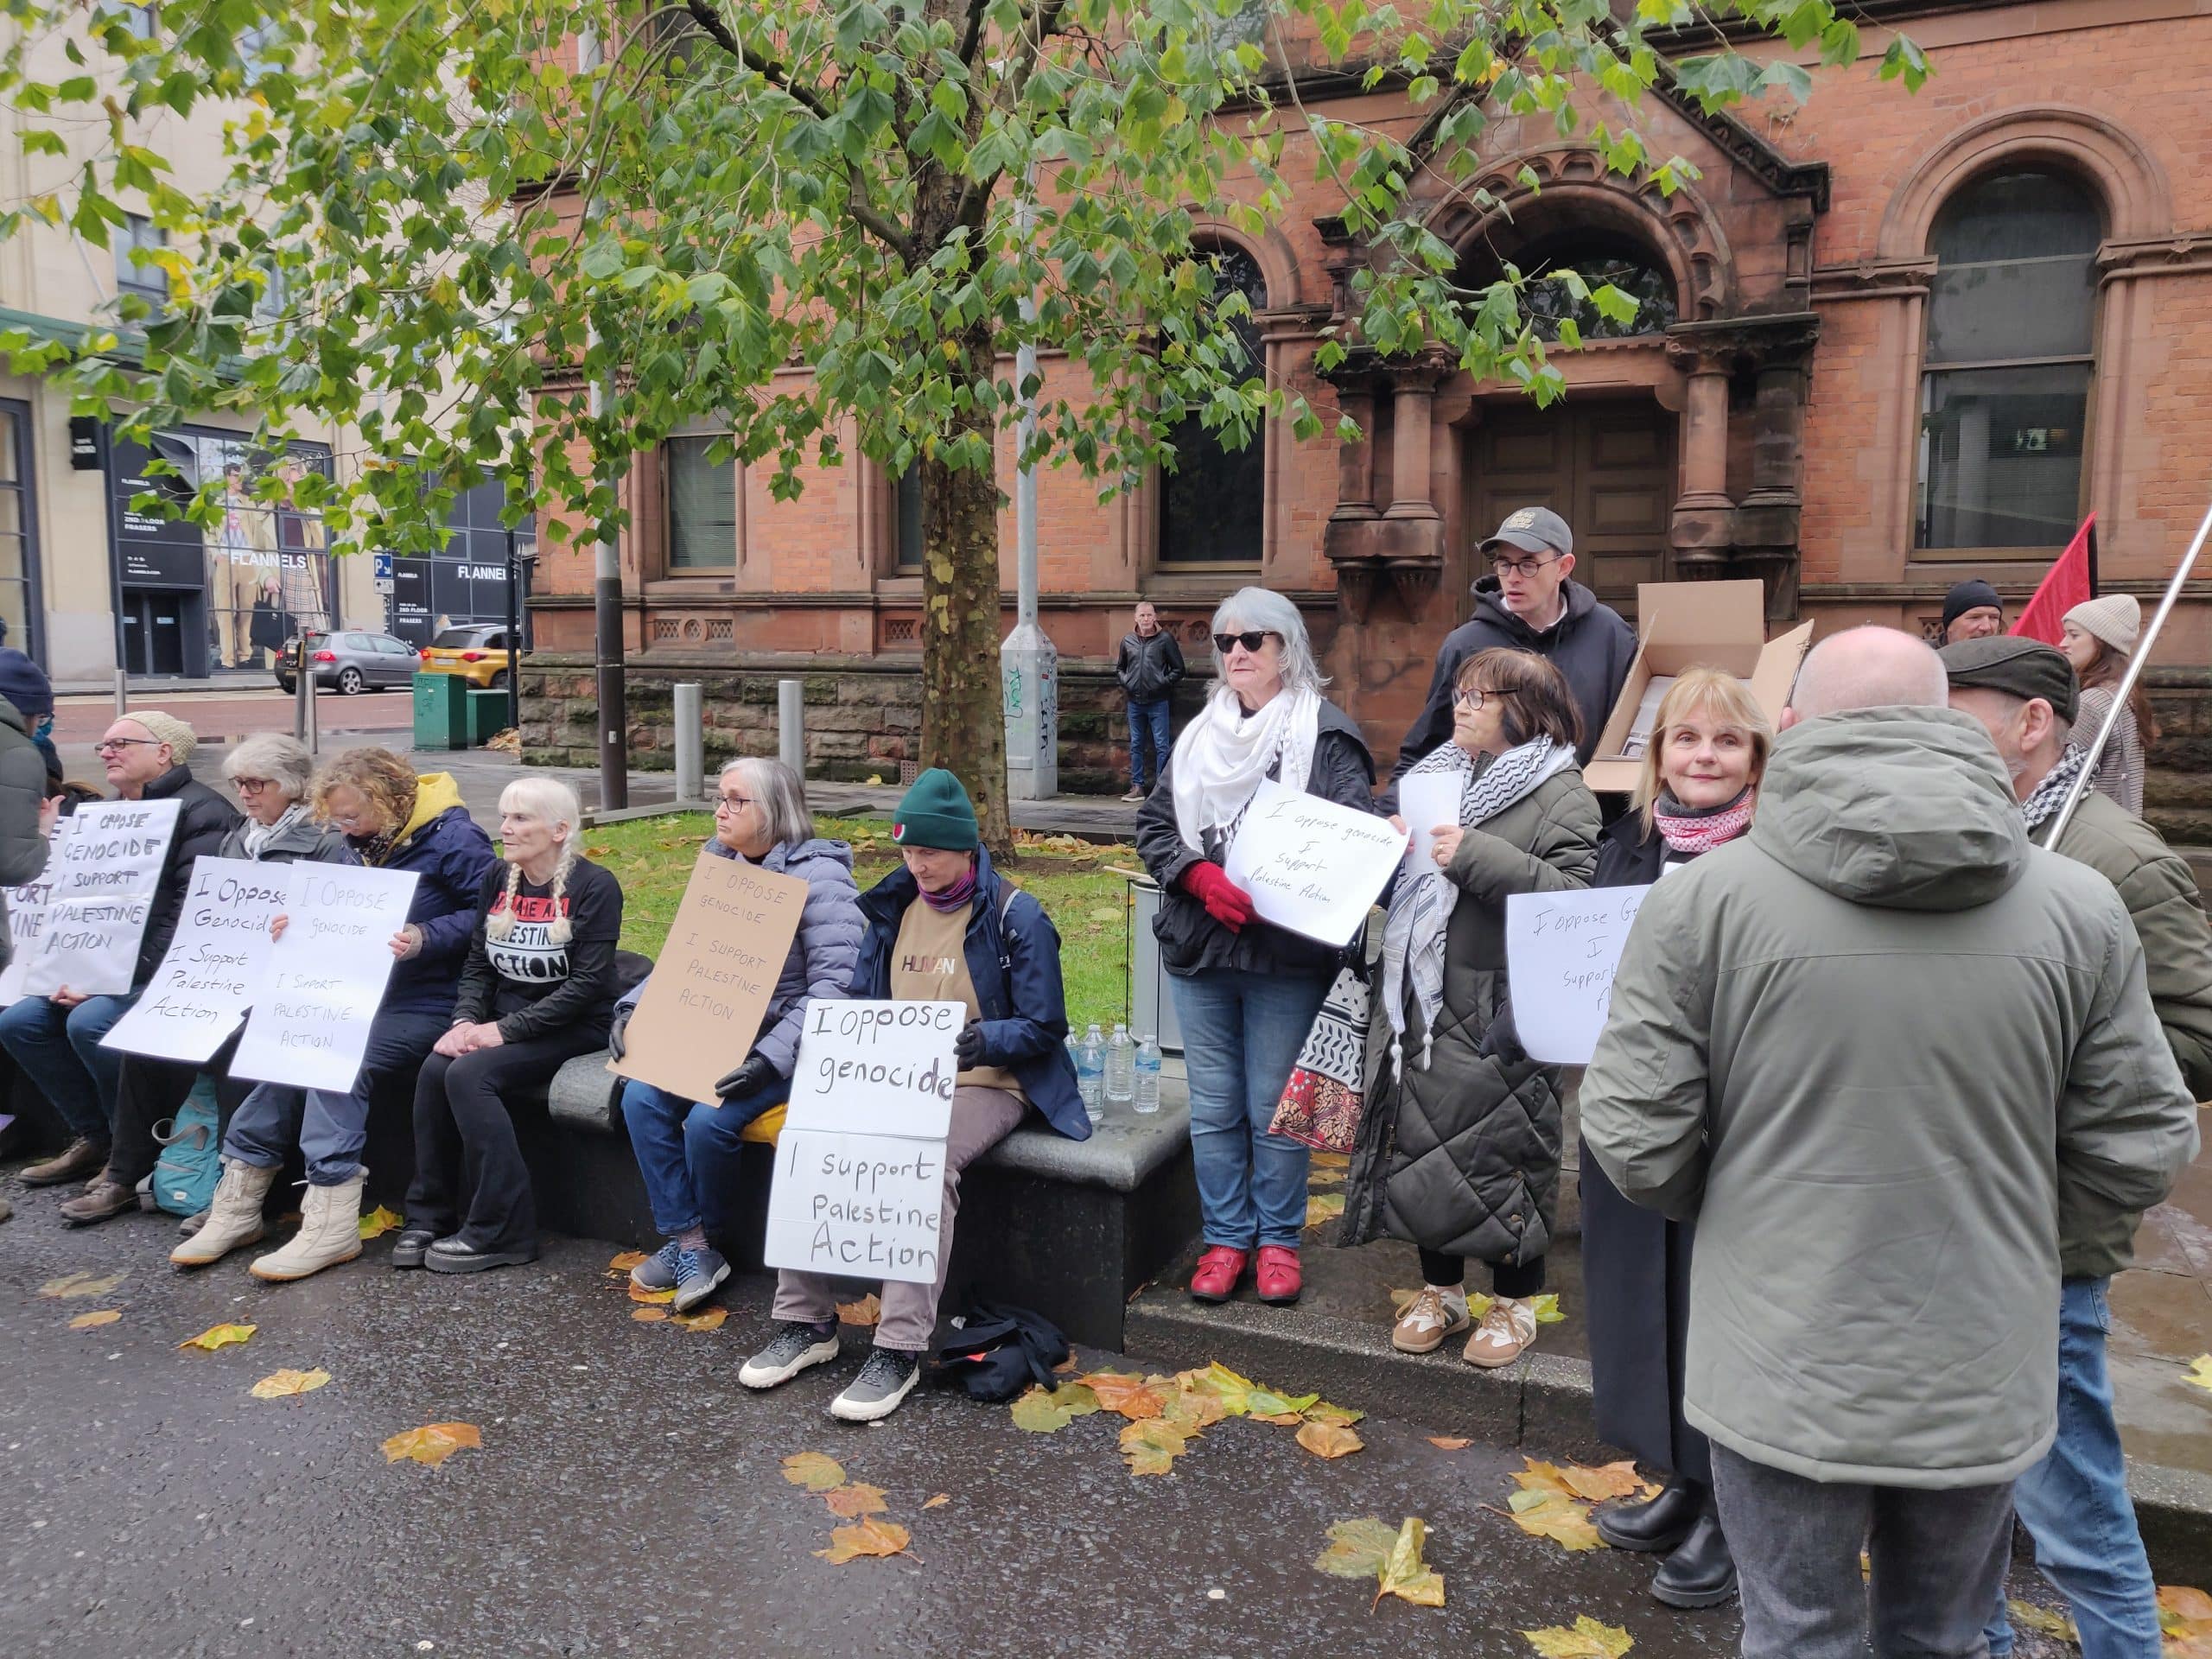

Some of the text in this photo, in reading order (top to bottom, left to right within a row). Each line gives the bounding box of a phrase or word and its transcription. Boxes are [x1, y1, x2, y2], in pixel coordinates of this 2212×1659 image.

[231, 553, 307, 569] FLANNELS
[375, 558, 383, 575] P
[1264, 799, 1298, 819] I
[73, 814, 88, 835] I
[64, 839, 161, 862] GENOCIDE
[74, 870, 138, 887] SUPPORT
[194, 873, 213, 896] I
[704, 866, 788, 905] I OPPOSE
[1250, 865, 1292, 891] Palestine
[300, 876, 318, 907] I
[52, 904, 145, 925] PALESTINE
[194, 909, 270, 932] Genocid
[700, 894, 766, 925] GENOCIDE
[1533, 908, 1554, 937] I
[45, 931, 112, 954] ACTION
[685, 932, 767, 969] I SUPPORT
[1586, 935, 1610, 958] I
[166, 943, 249, 975] I Support
[166, 969, 245, 995] Palestine
[276, 973, 286, 988] I
[687, 959, 761, 995] PALESTINE
[145, 995, 219, 1023] Action
[273, 1002, 353, 1022] PALESTINE
[678, 988, 734, 1020] ACTION
[810, 1004, 953, 1045] I oppose
[281, 1030, 334, 1048] ACTION
[815, 1056, 953, 1102] genocide
[821, 1151, 938, 1194] support
[812, 1194, 939, 1231] Palestine
[810, 1220, 939, 1273] Action
